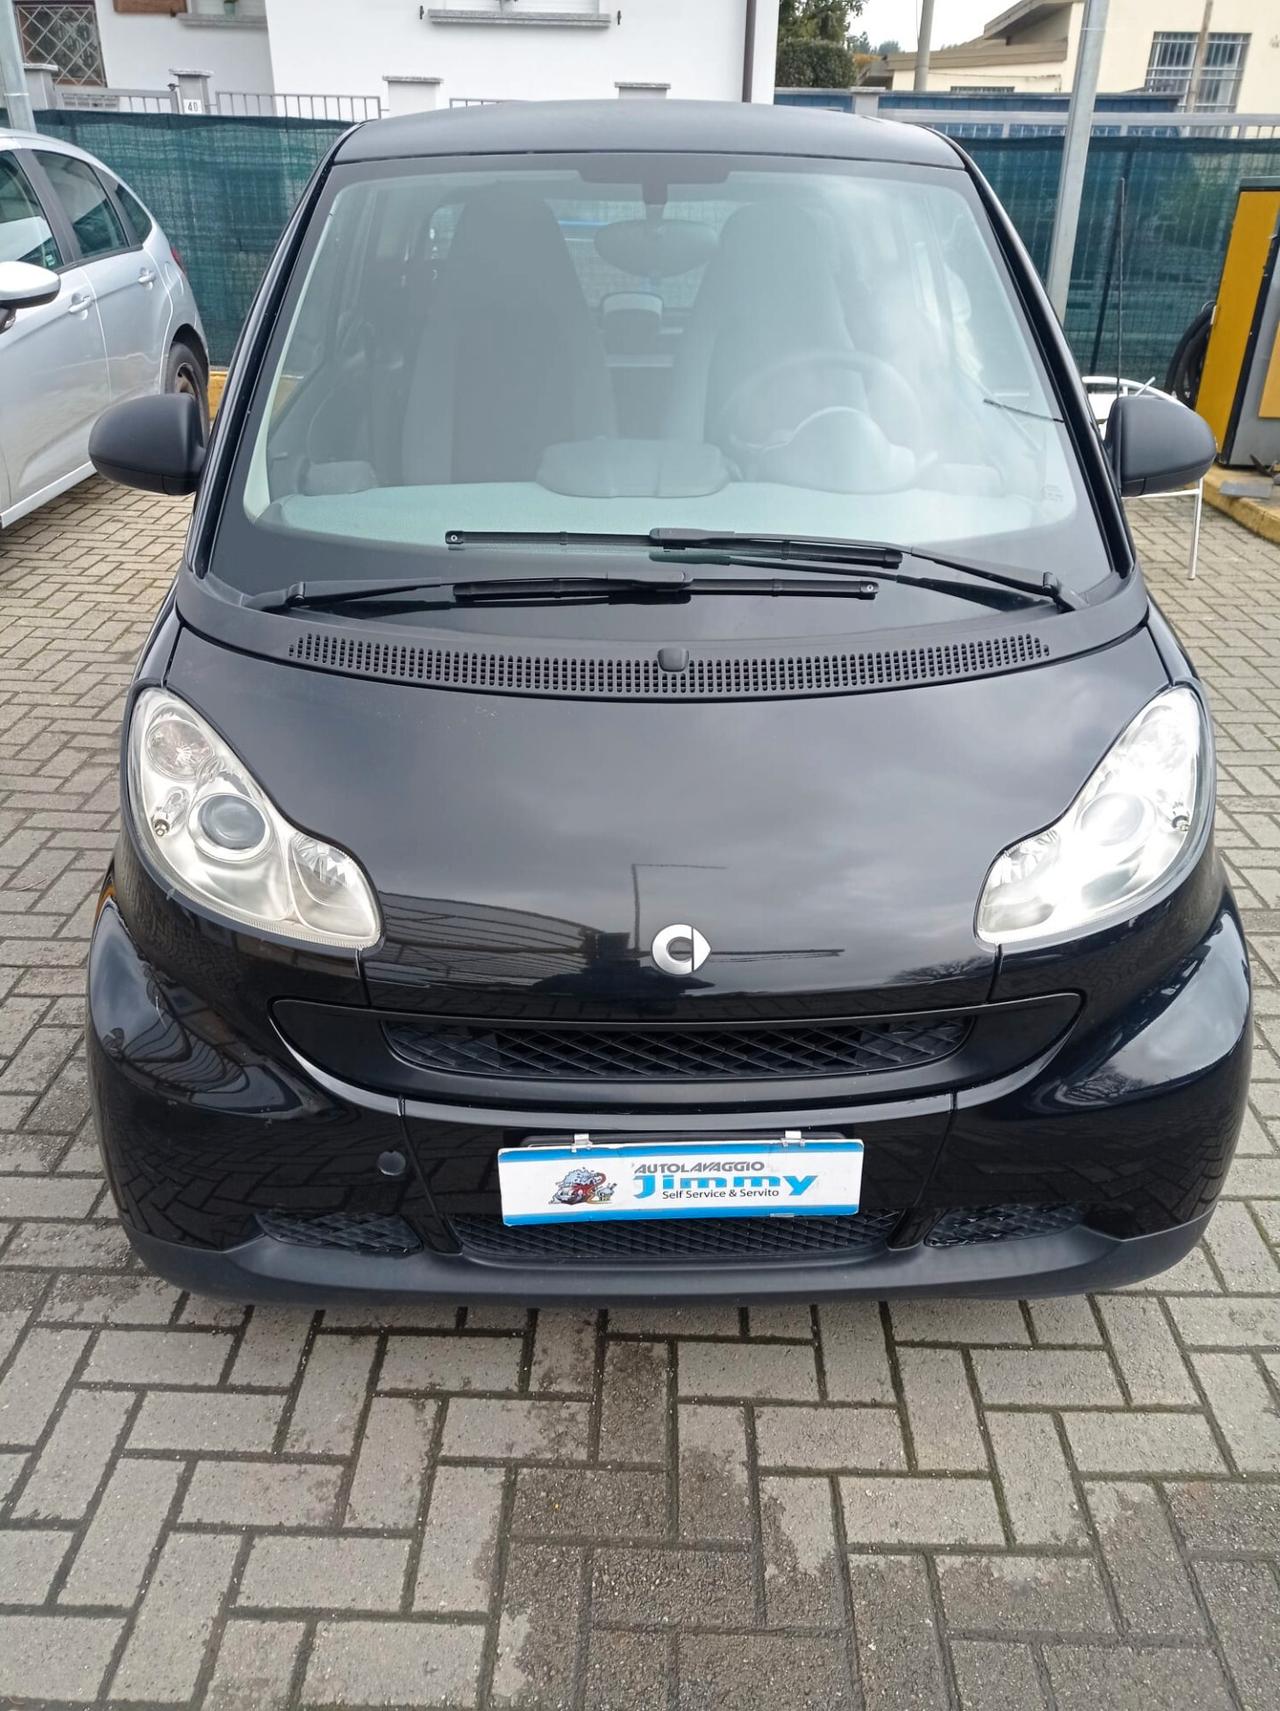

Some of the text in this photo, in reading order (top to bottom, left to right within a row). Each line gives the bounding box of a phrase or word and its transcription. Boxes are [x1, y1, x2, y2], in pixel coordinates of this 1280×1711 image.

[634, 1161, 765, 1174] AUTOLAVAGGIO
[633, 1174, 818, 1199] Jimmy
[662, 1188, 780, 1200] Self Service & Servito
